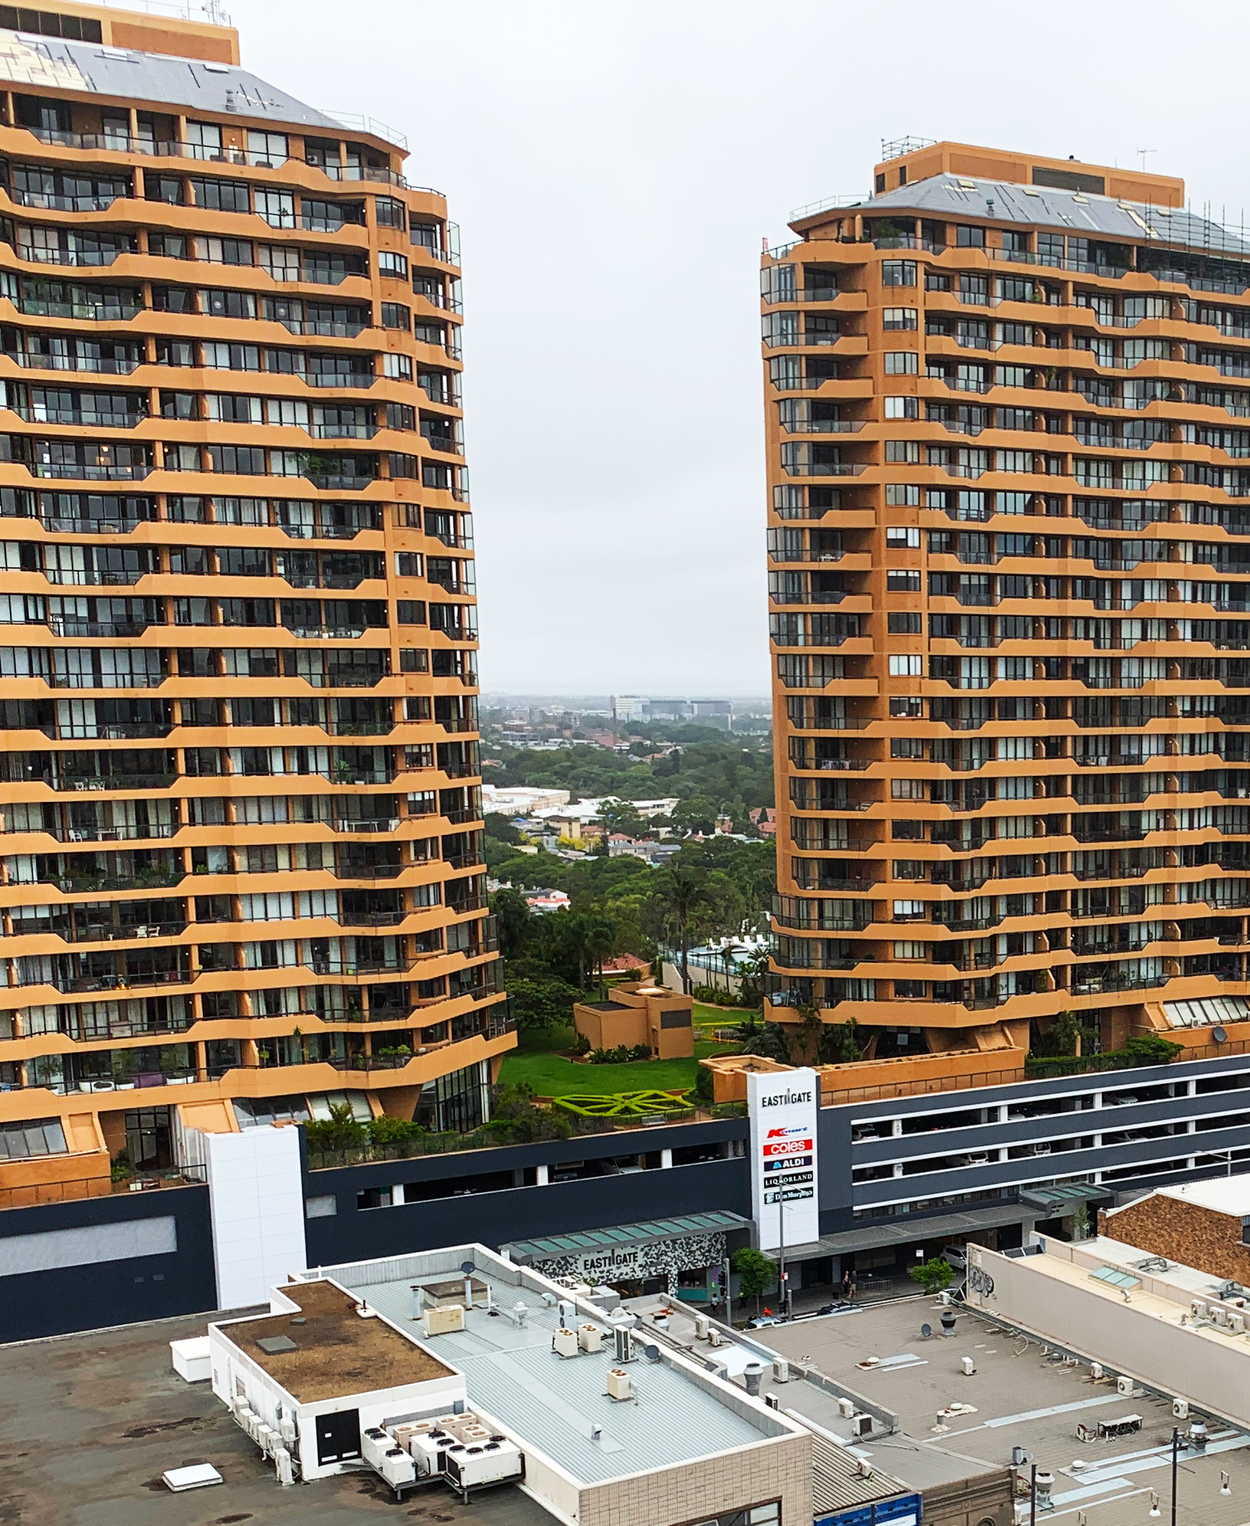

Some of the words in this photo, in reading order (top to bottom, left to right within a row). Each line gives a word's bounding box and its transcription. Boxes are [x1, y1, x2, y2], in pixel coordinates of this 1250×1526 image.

[770, 1140, 806, 1155] coles
[782, 1157, 805, 1168] ALDI
[765, 1173, 812, 1186] LIQORLAND
